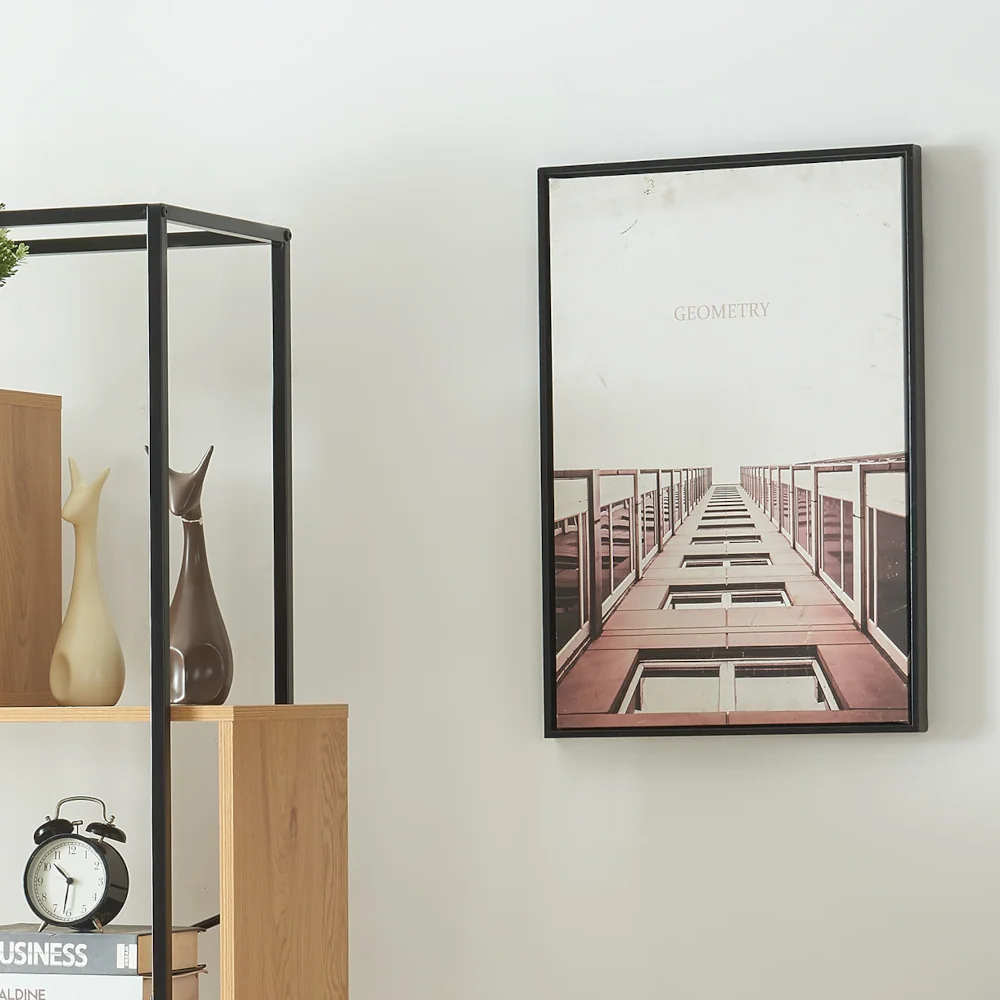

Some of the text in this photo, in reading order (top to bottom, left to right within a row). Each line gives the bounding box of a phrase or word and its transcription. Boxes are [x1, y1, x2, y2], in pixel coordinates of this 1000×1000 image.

[673, 301, 771, 322] GEOMETRY
[54, 850, 61, 860] 11
[68, 846, 77, 855] 12
[43, 862, 52, 872] 10
[93, 862, 100, 870] 2
[37, 877, 43, 886] 9
[98, 878, 104, 886] 3
[41, 893, 47, 901] 8
[92, 892, 97, 901] 4
[52, 903, 58, 913] 7
[81, 905, 87, 914] 5
[65, 909, 72, 917] 6
